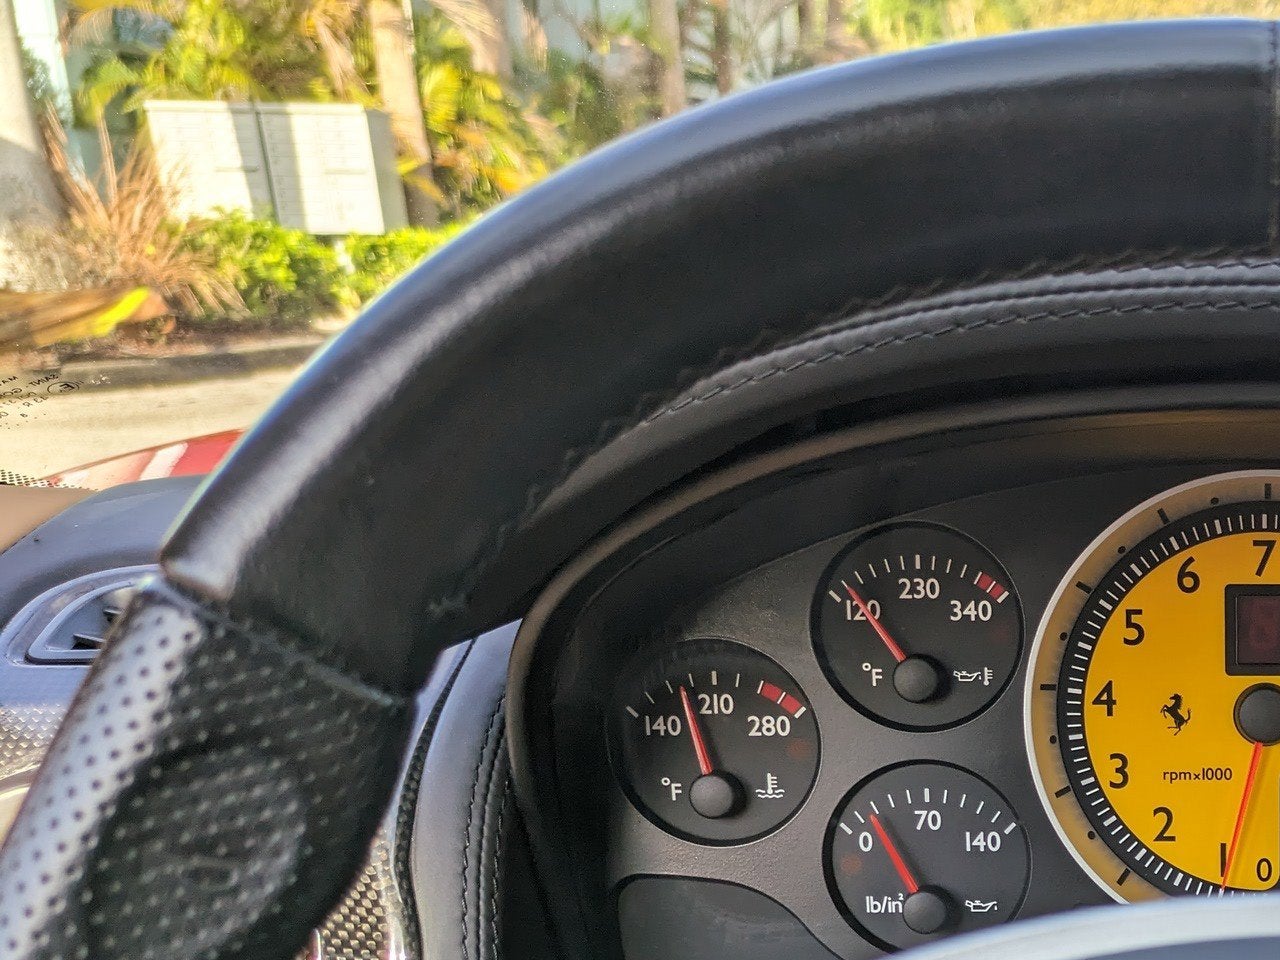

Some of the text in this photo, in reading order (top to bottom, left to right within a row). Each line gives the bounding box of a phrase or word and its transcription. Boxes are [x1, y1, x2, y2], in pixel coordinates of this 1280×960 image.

[1251, 539, 1277, 577] 7
[1175, 555, 1201, 594] 6
[898, 577, 940, 600] 230
[845, 600, 881, 621] 120
[949, 600, 992, 622] 340
[1122, 607, 1146, 647] 5
[697, 693, 735, 715] 210
[1091, 678, 1118, 717] 4
[644, 715, 682, 737] 140
[747, 715, 791, 737] 280
[1108, 752, 1131, 790] 3
[913, 809, 942, 831] 70
[1151, 805, 1177, 843] 2
[858, 831, 873, 853] 0
[965, 831, 1001, 852] 140
[1255, 857, 1273, 882] 0
